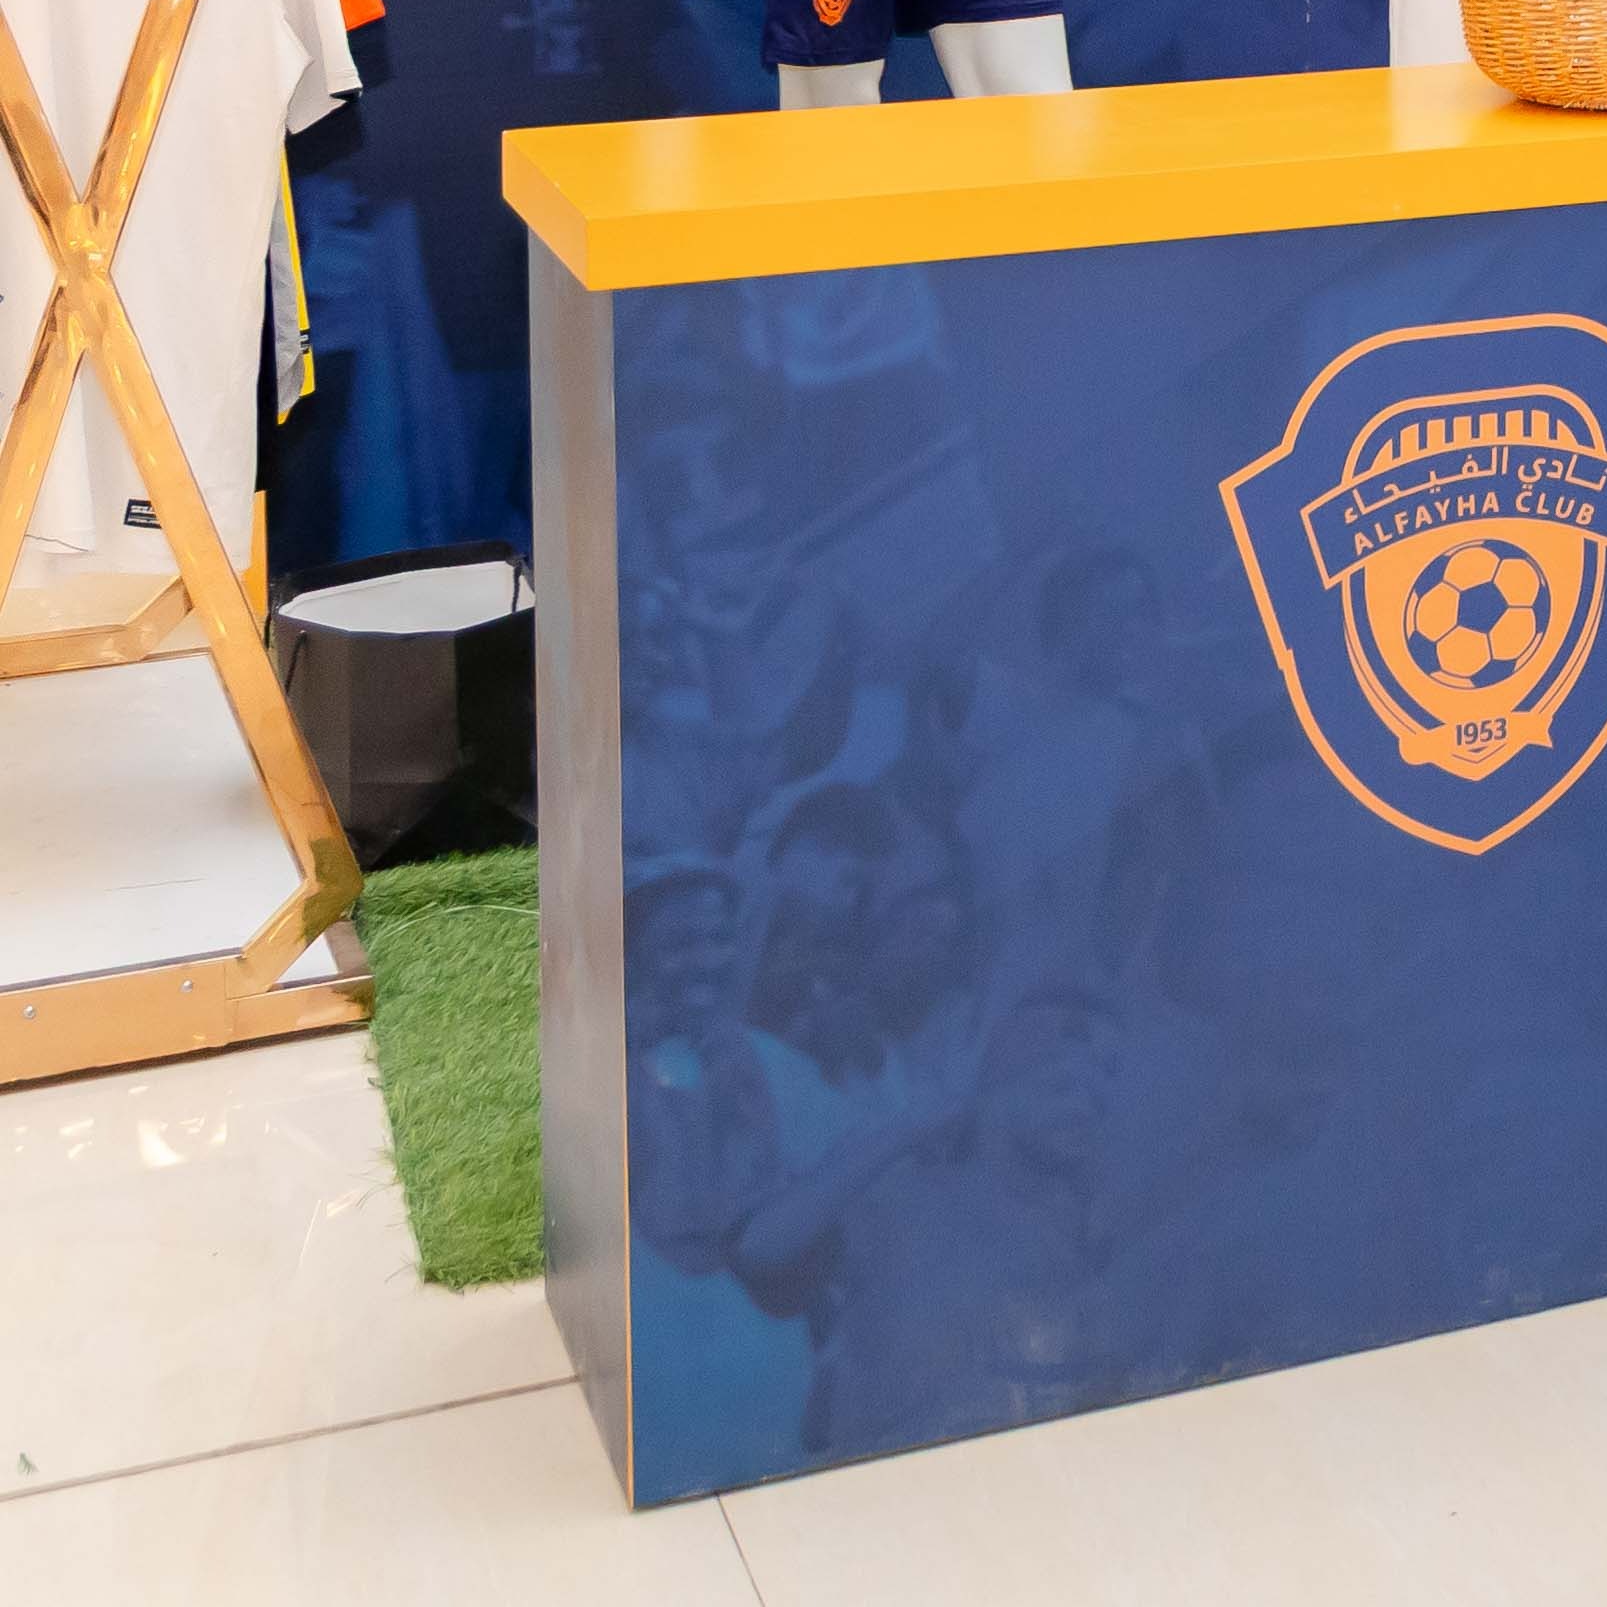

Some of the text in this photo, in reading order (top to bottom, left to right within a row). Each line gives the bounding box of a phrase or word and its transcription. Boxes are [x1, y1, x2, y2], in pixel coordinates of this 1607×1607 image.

[1343, 445, 1509, 524] الفيحاء
[1354, 491, 1596, 556] ALFAYHA CLUB
[1455, 717, 1508, 746] 1953
